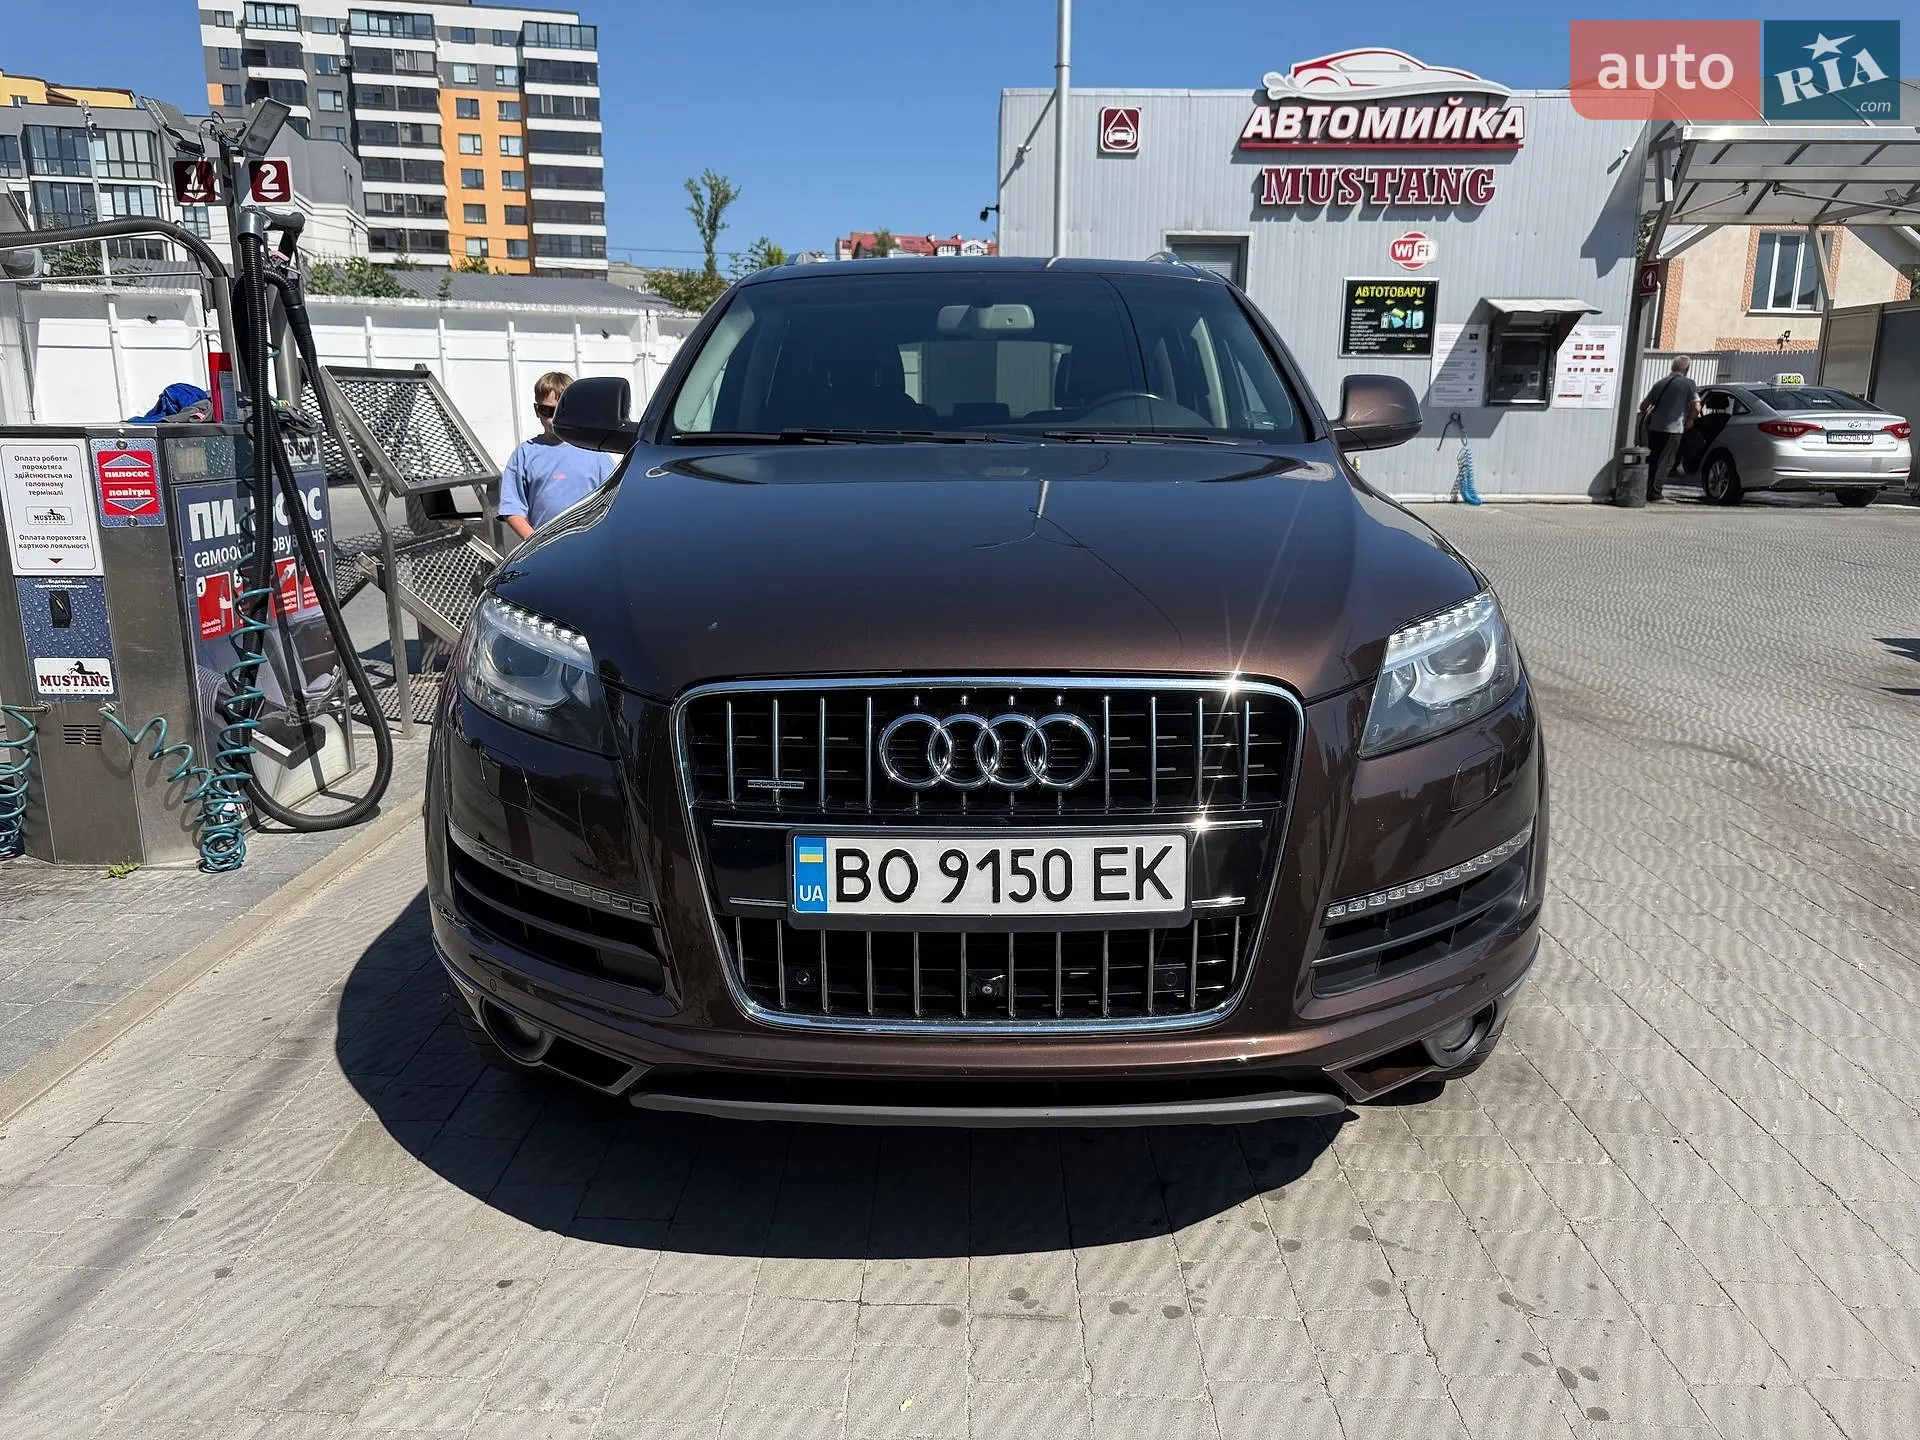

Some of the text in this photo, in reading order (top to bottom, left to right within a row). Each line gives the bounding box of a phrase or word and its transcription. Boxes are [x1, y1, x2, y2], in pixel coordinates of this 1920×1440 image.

[1241, 97, 1525, 140] АВТОМИЙКА
[260, 163, 280, 190] 2
[1261, 166, 1496, 206] MUSTANG
[42, 455, 68, 463] роботи
[25, 481, 64, 489] головному
[108, 488, 151, 497] повітря
[18, 541, 90, 550] карткою лояльності
[39, 675, 110, 687] MUSTANG
[836, 845, 1173, 904] BO 9150 EK
[800, 885, 825, 902] UA
